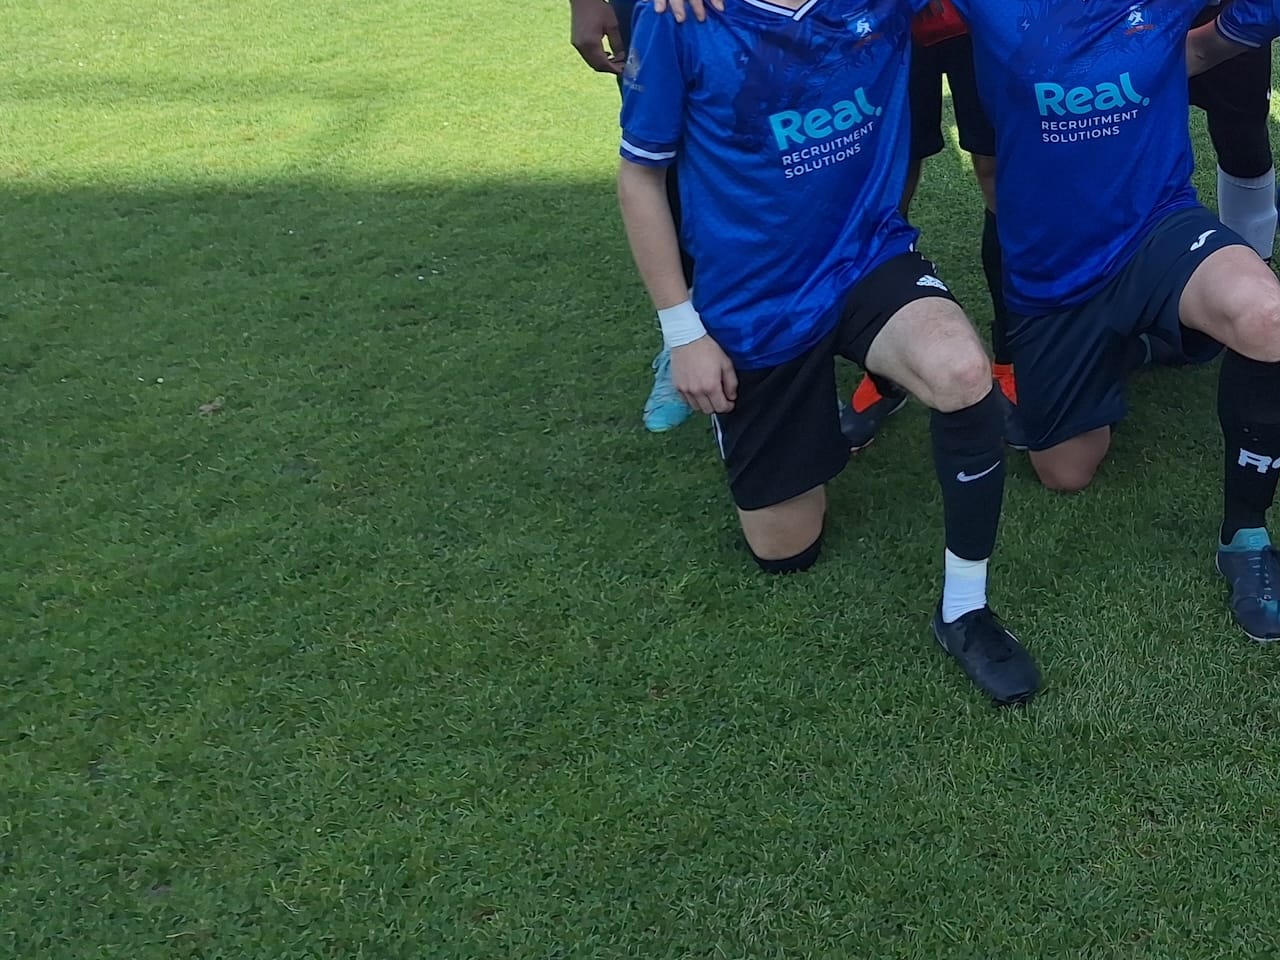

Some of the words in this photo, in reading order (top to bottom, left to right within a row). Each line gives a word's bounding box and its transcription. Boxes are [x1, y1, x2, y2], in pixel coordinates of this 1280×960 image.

[1034, 72, 1151, 117] Real.
[768, 86, 883, 151] Real.
[1041, 109, 1139, 131] RECRUITMENT
[1042, 126, 1120, 143] SOLUTIONS
[782, 121, 875, 166] RECRUITMENT
[784, 143, 861, 179] SOLUTIONS
